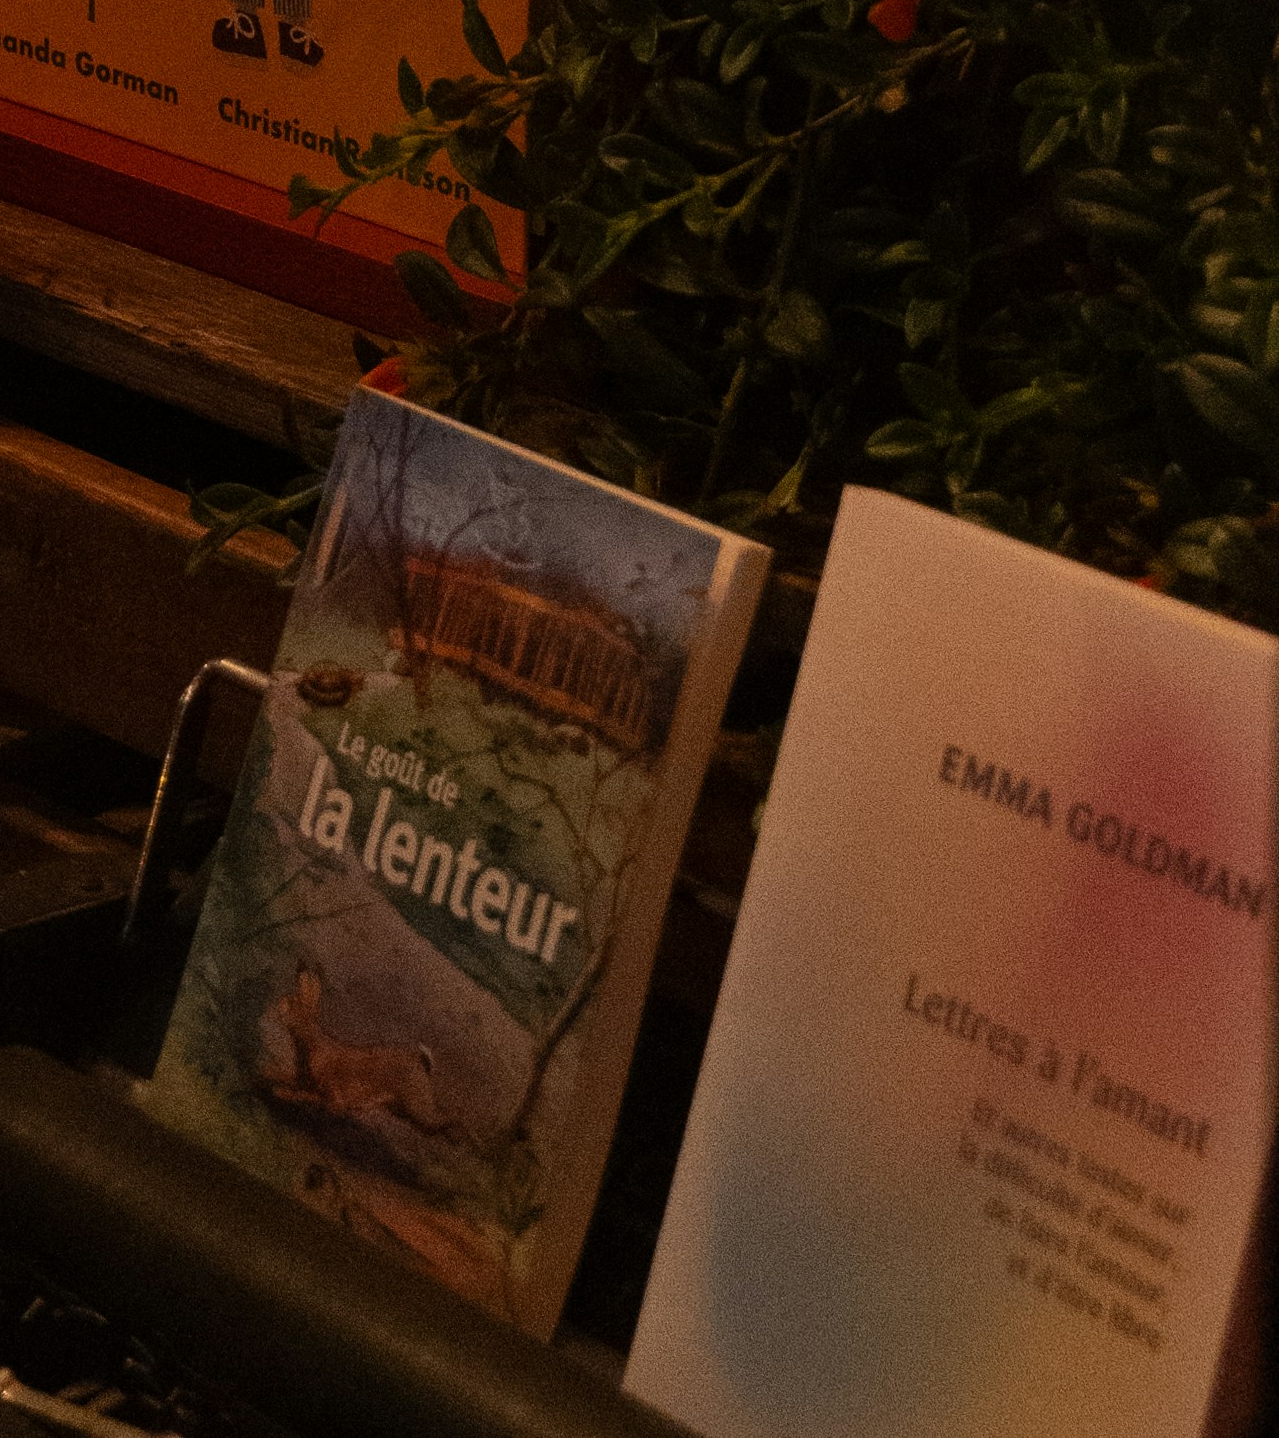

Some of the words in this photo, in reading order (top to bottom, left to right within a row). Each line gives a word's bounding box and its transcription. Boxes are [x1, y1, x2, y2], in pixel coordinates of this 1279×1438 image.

[74, 51, 181, 108] Gorman
[217, 95, 336, 157] Christian
[336, 721, 367, 763] Le
[365, 744, 426, 792] goût
[427, 770, 459, 811] de
[939, 743, 1054, 830] EMMA
[1065, 801, 1267, 920] GOLDMAN
[298, 754, 355, 853] la
[362, 785, 581, 965] lenteur
[904, 972, 1029, 1068] Lettres
[1040, 1041, 1060, 1083] à
[1073, 1050, 1212, 1157] l'amant
